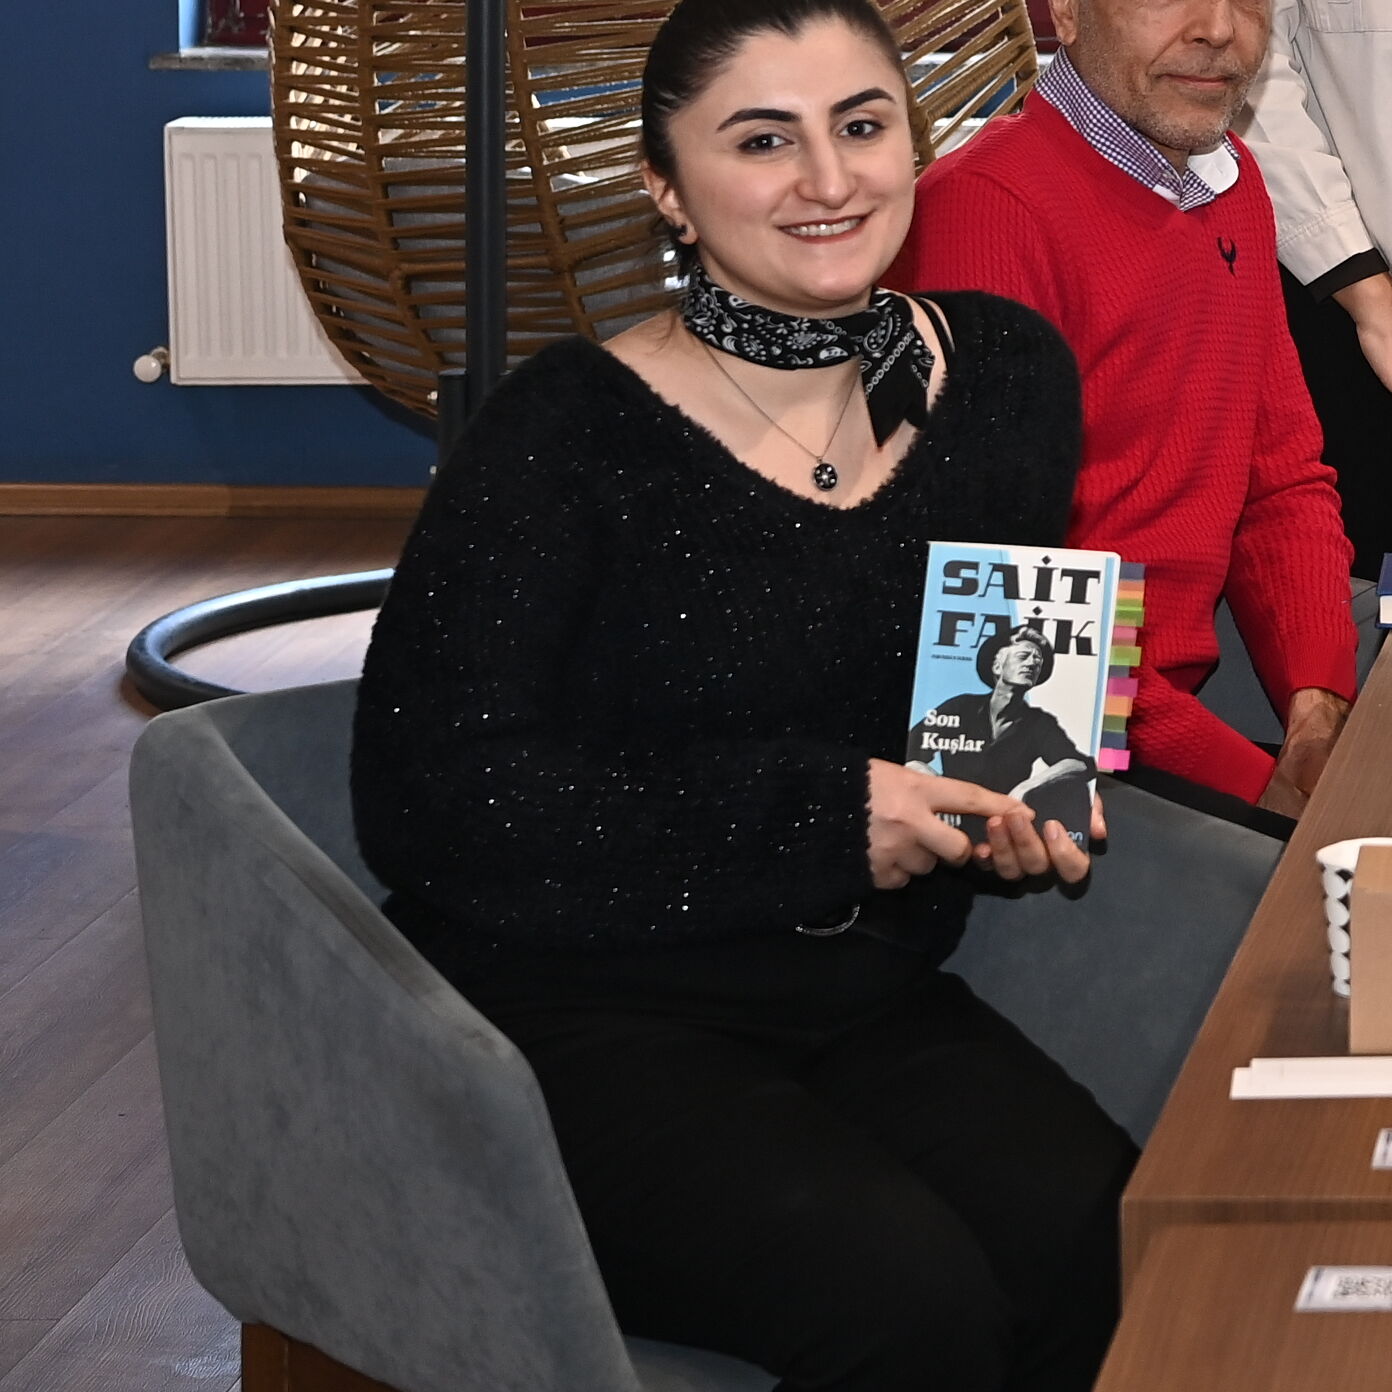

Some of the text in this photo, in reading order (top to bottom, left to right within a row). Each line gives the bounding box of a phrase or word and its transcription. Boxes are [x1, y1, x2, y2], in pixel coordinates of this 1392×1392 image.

[942, 555, 1102, 605] SAİT
[924, 709, 961, 728] Son
[921, 732, 986, 755] Kuşlar
